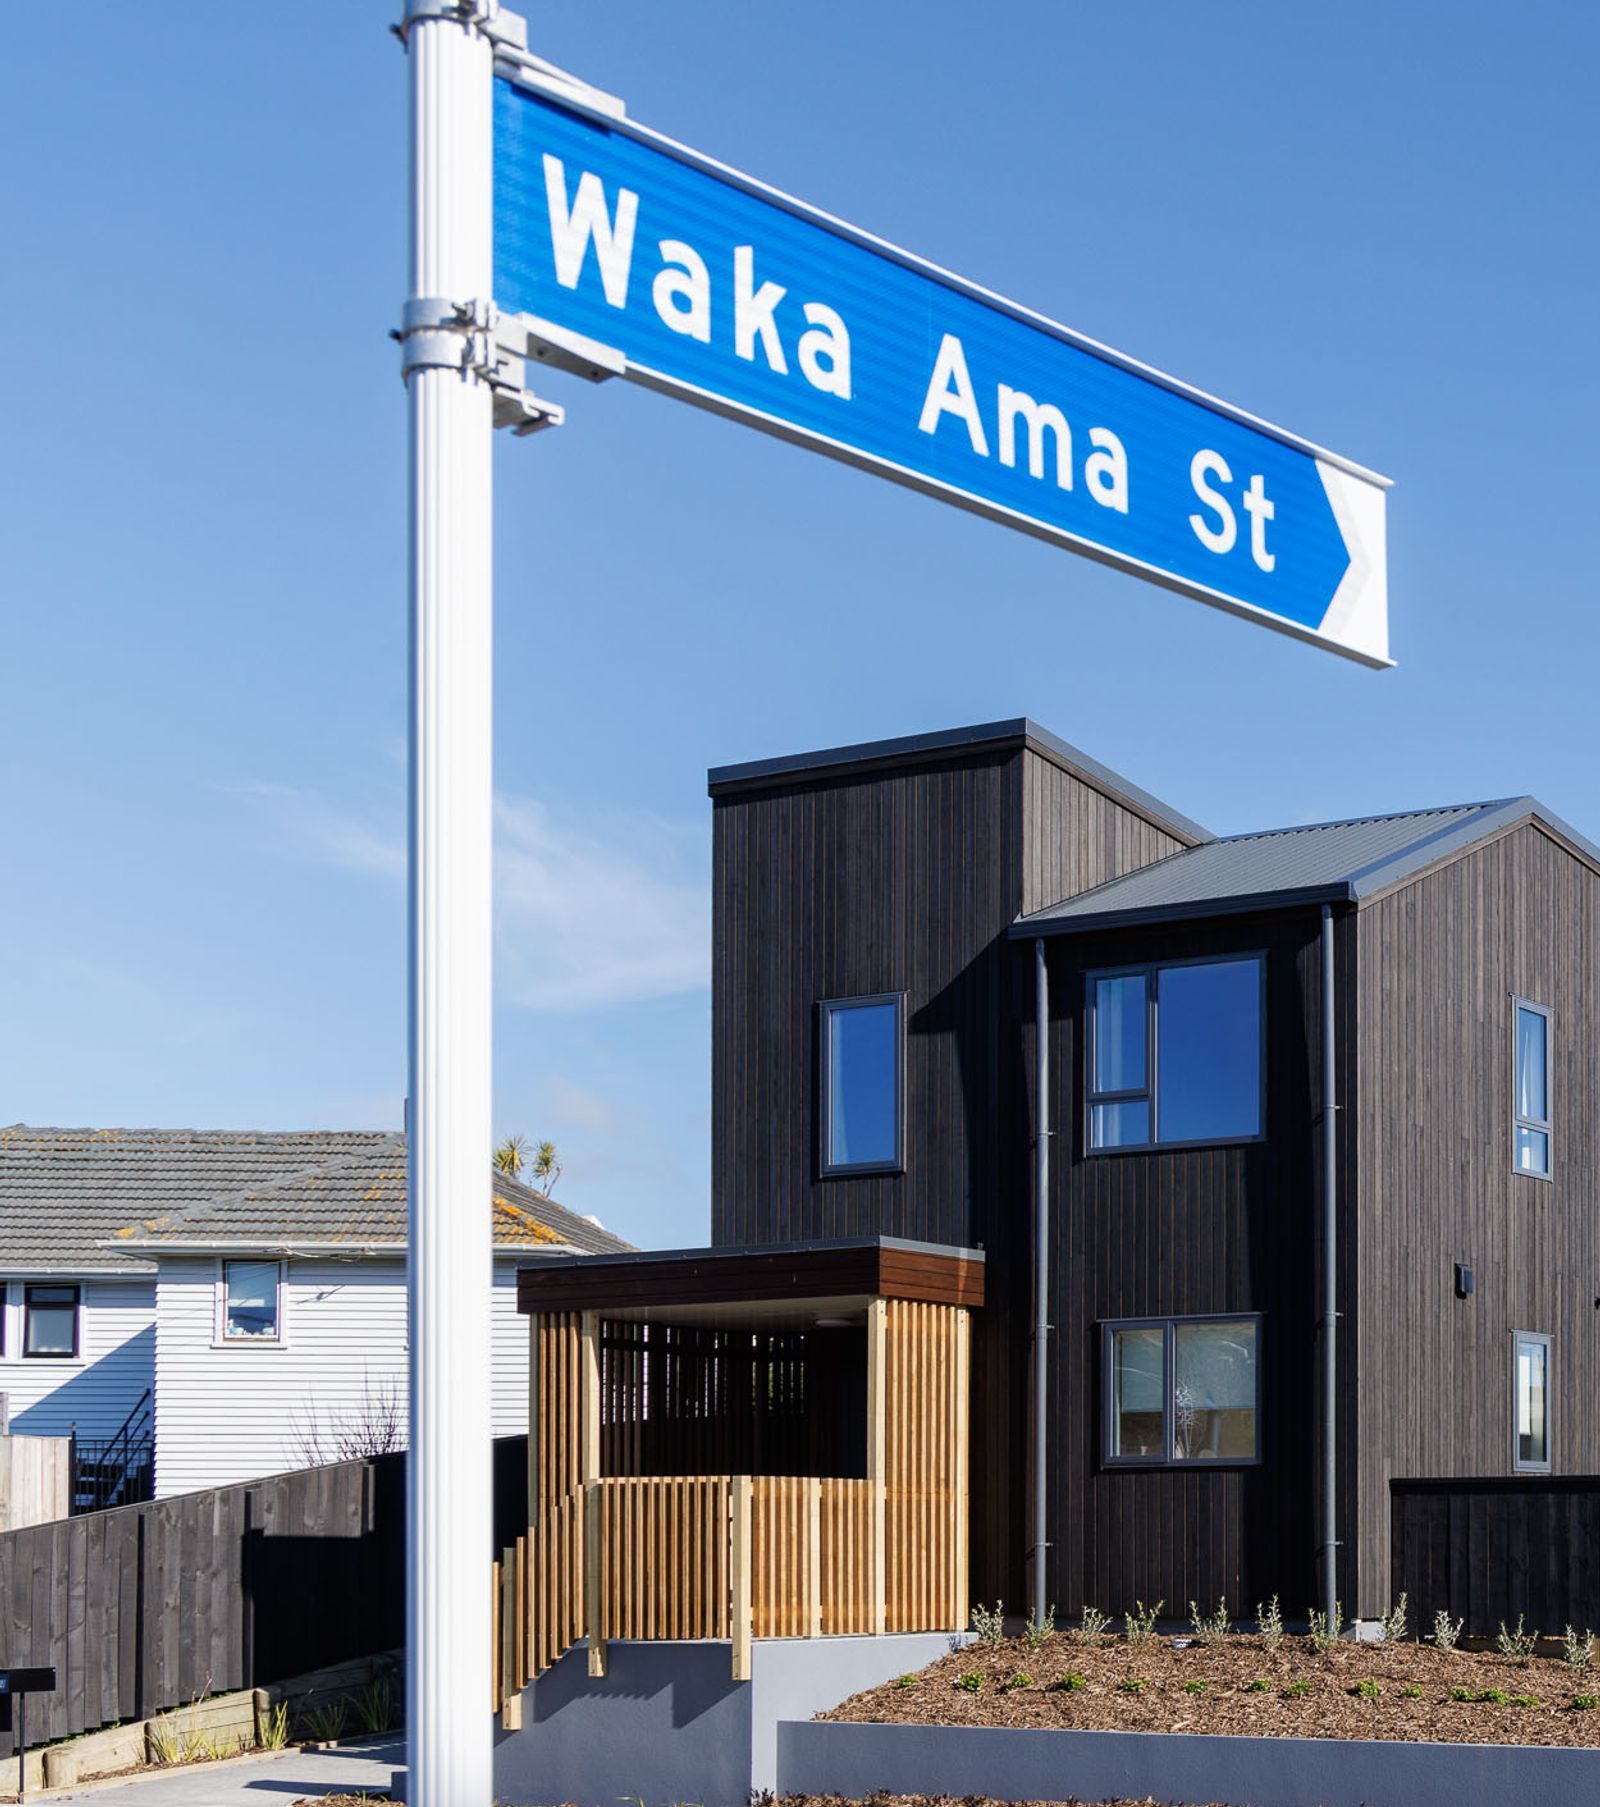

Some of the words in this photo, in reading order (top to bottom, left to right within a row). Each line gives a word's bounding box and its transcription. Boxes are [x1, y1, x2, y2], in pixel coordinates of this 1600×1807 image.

[542, 153, 852, 400] Waka
[918, 333, 1129, 514] Ama
[1189, 449, 1275, 572] St
